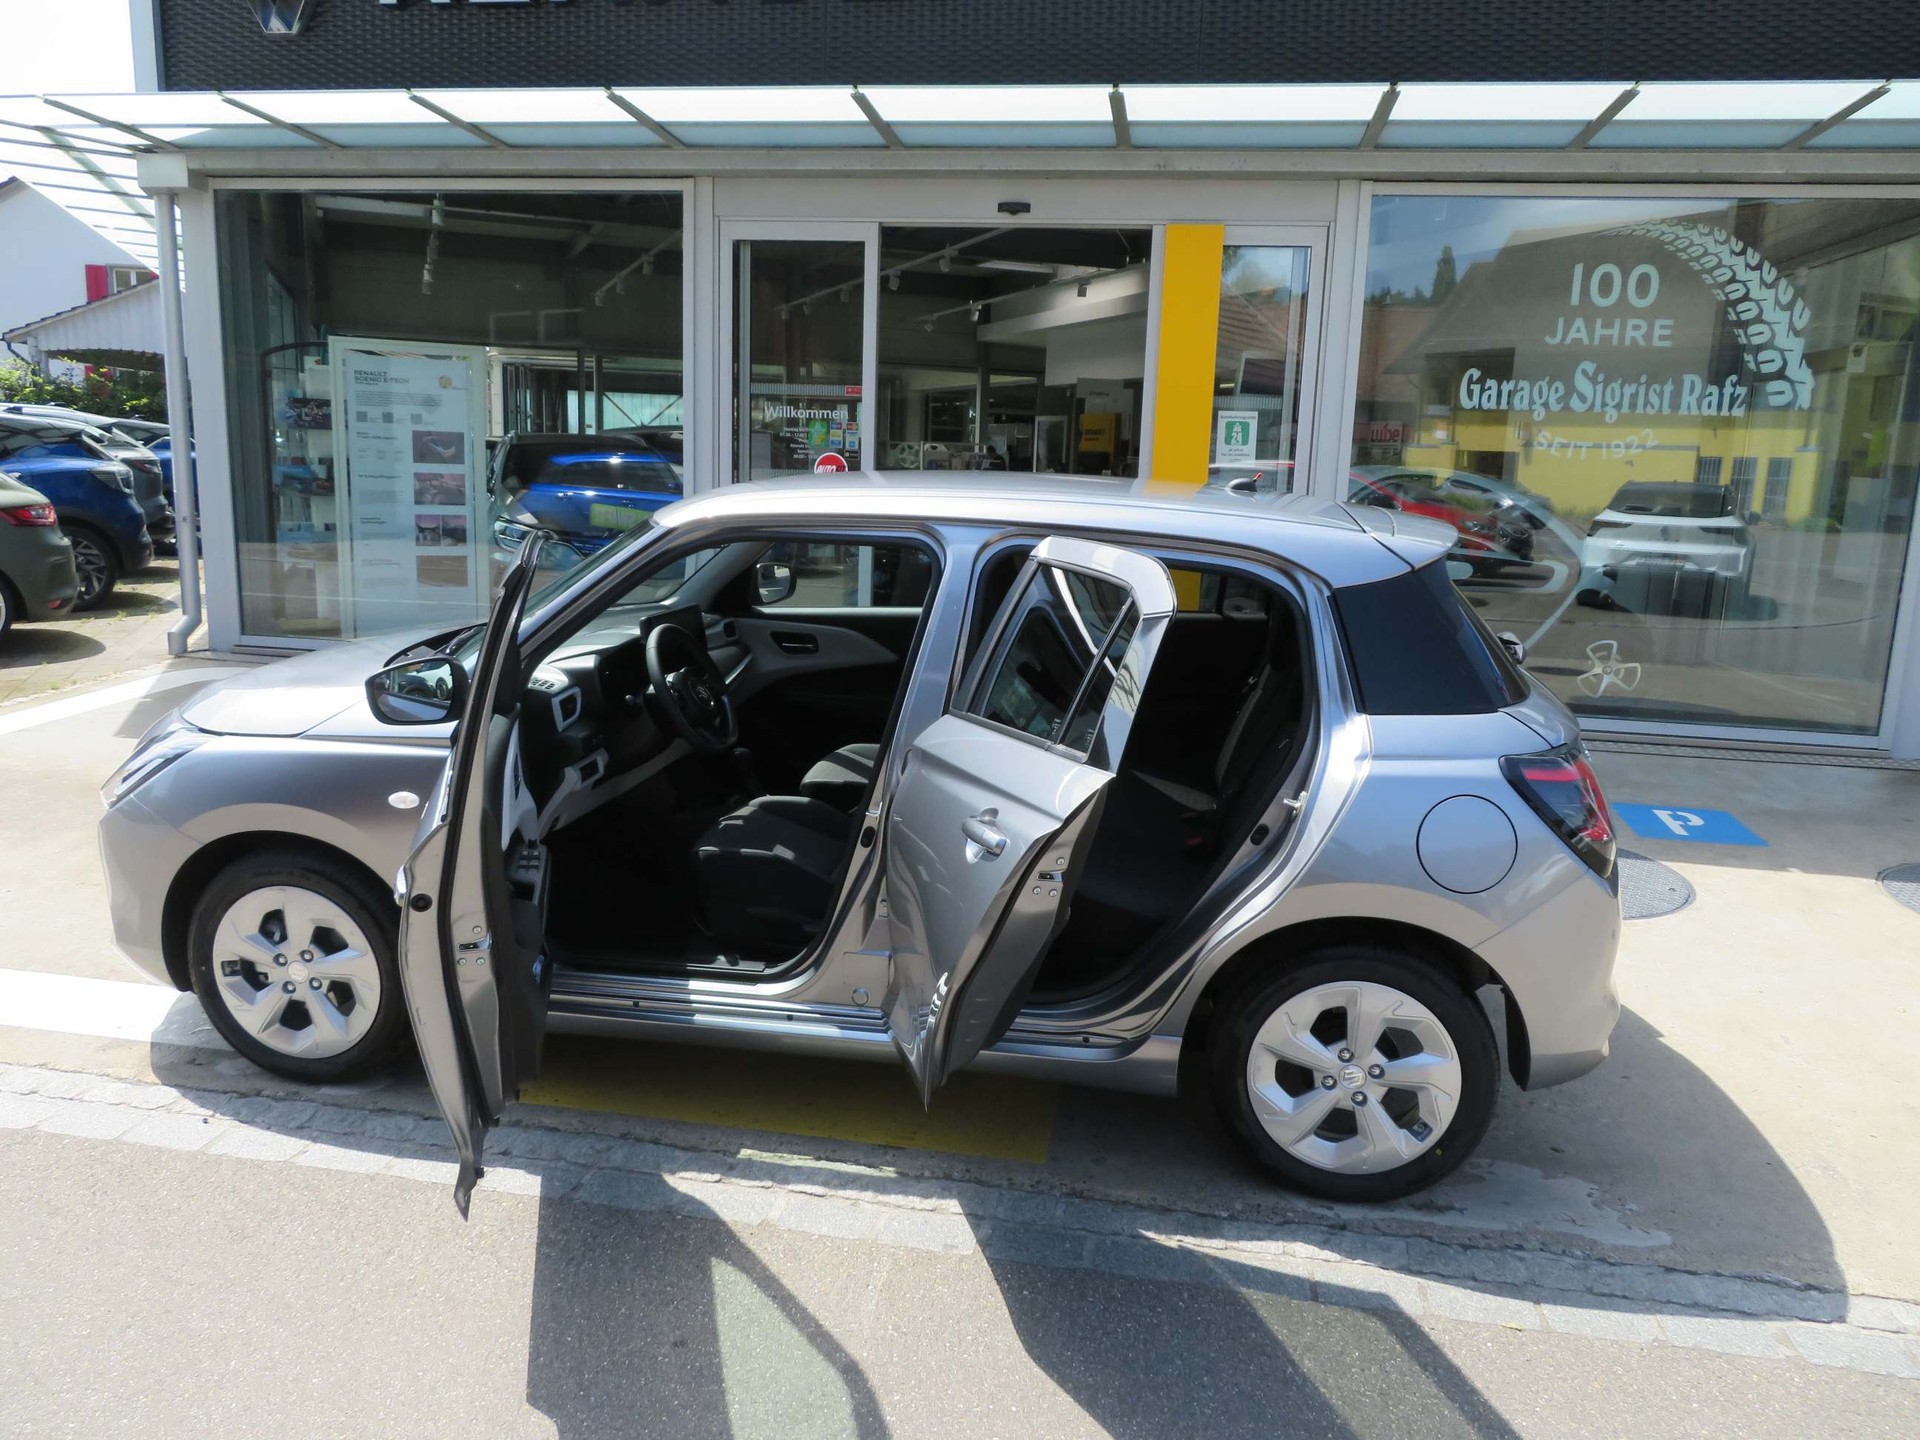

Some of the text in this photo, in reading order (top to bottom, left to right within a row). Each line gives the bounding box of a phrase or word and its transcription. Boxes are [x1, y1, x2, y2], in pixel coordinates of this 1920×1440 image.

[1570, 263, 1660, 308] 100
[1544, 316, 1675, 348] JAHRE
[1460, 360, 1748, 423] Garage Sigrist Rafz
[765, 405, 849, 420] Willkommen
[1534, 428, 1660, 461] SEIT 1922
[1652, 809, 1704, 836] P
